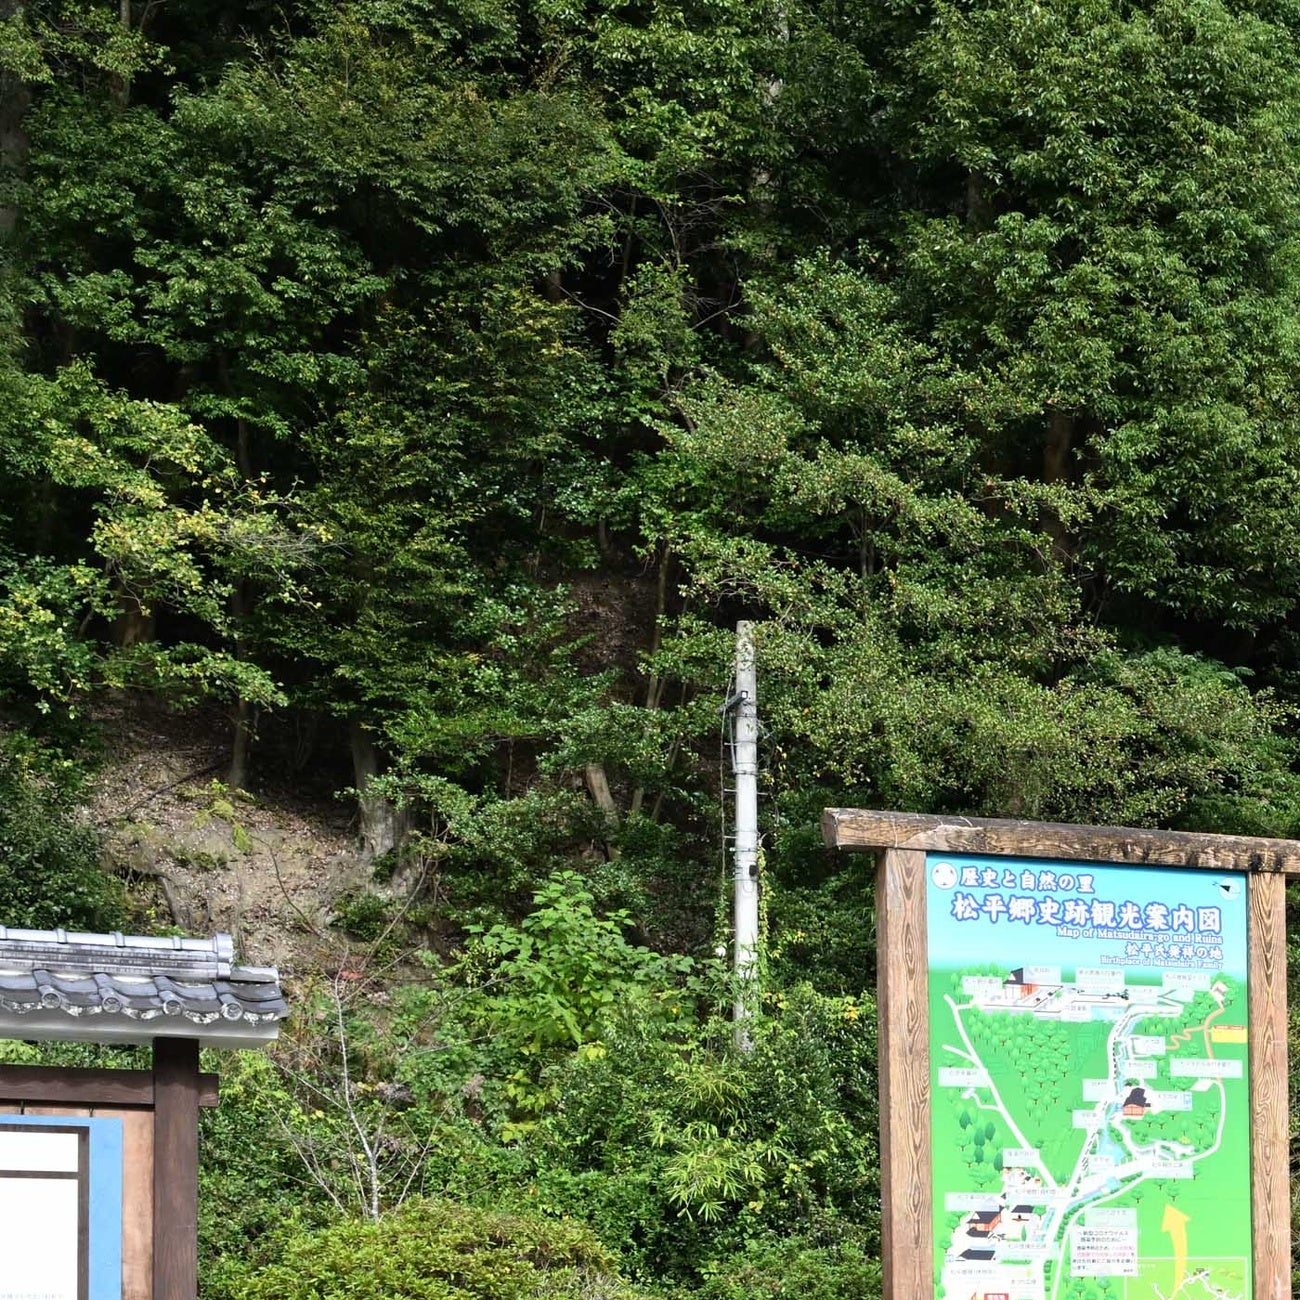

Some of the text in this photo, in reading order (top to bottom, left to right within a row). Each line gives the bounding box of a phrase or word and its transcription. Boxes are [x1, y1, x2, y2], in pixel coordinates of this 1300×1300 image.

[960, 866, 1096, 894] 歴史と自然の里
[951, 892, 1223, 934] 松平郷史跡観光案内図
[1057, 927, 1223, 944] Map of Matsudaira-go and Ruins
[1125, 942, 1223, 960] 松平氏発祥の地
[1100, 955, 1140, 966] Birthplace
[1143, 957, 1152, 966] of
[1197, 960, 1223, 970] Family
